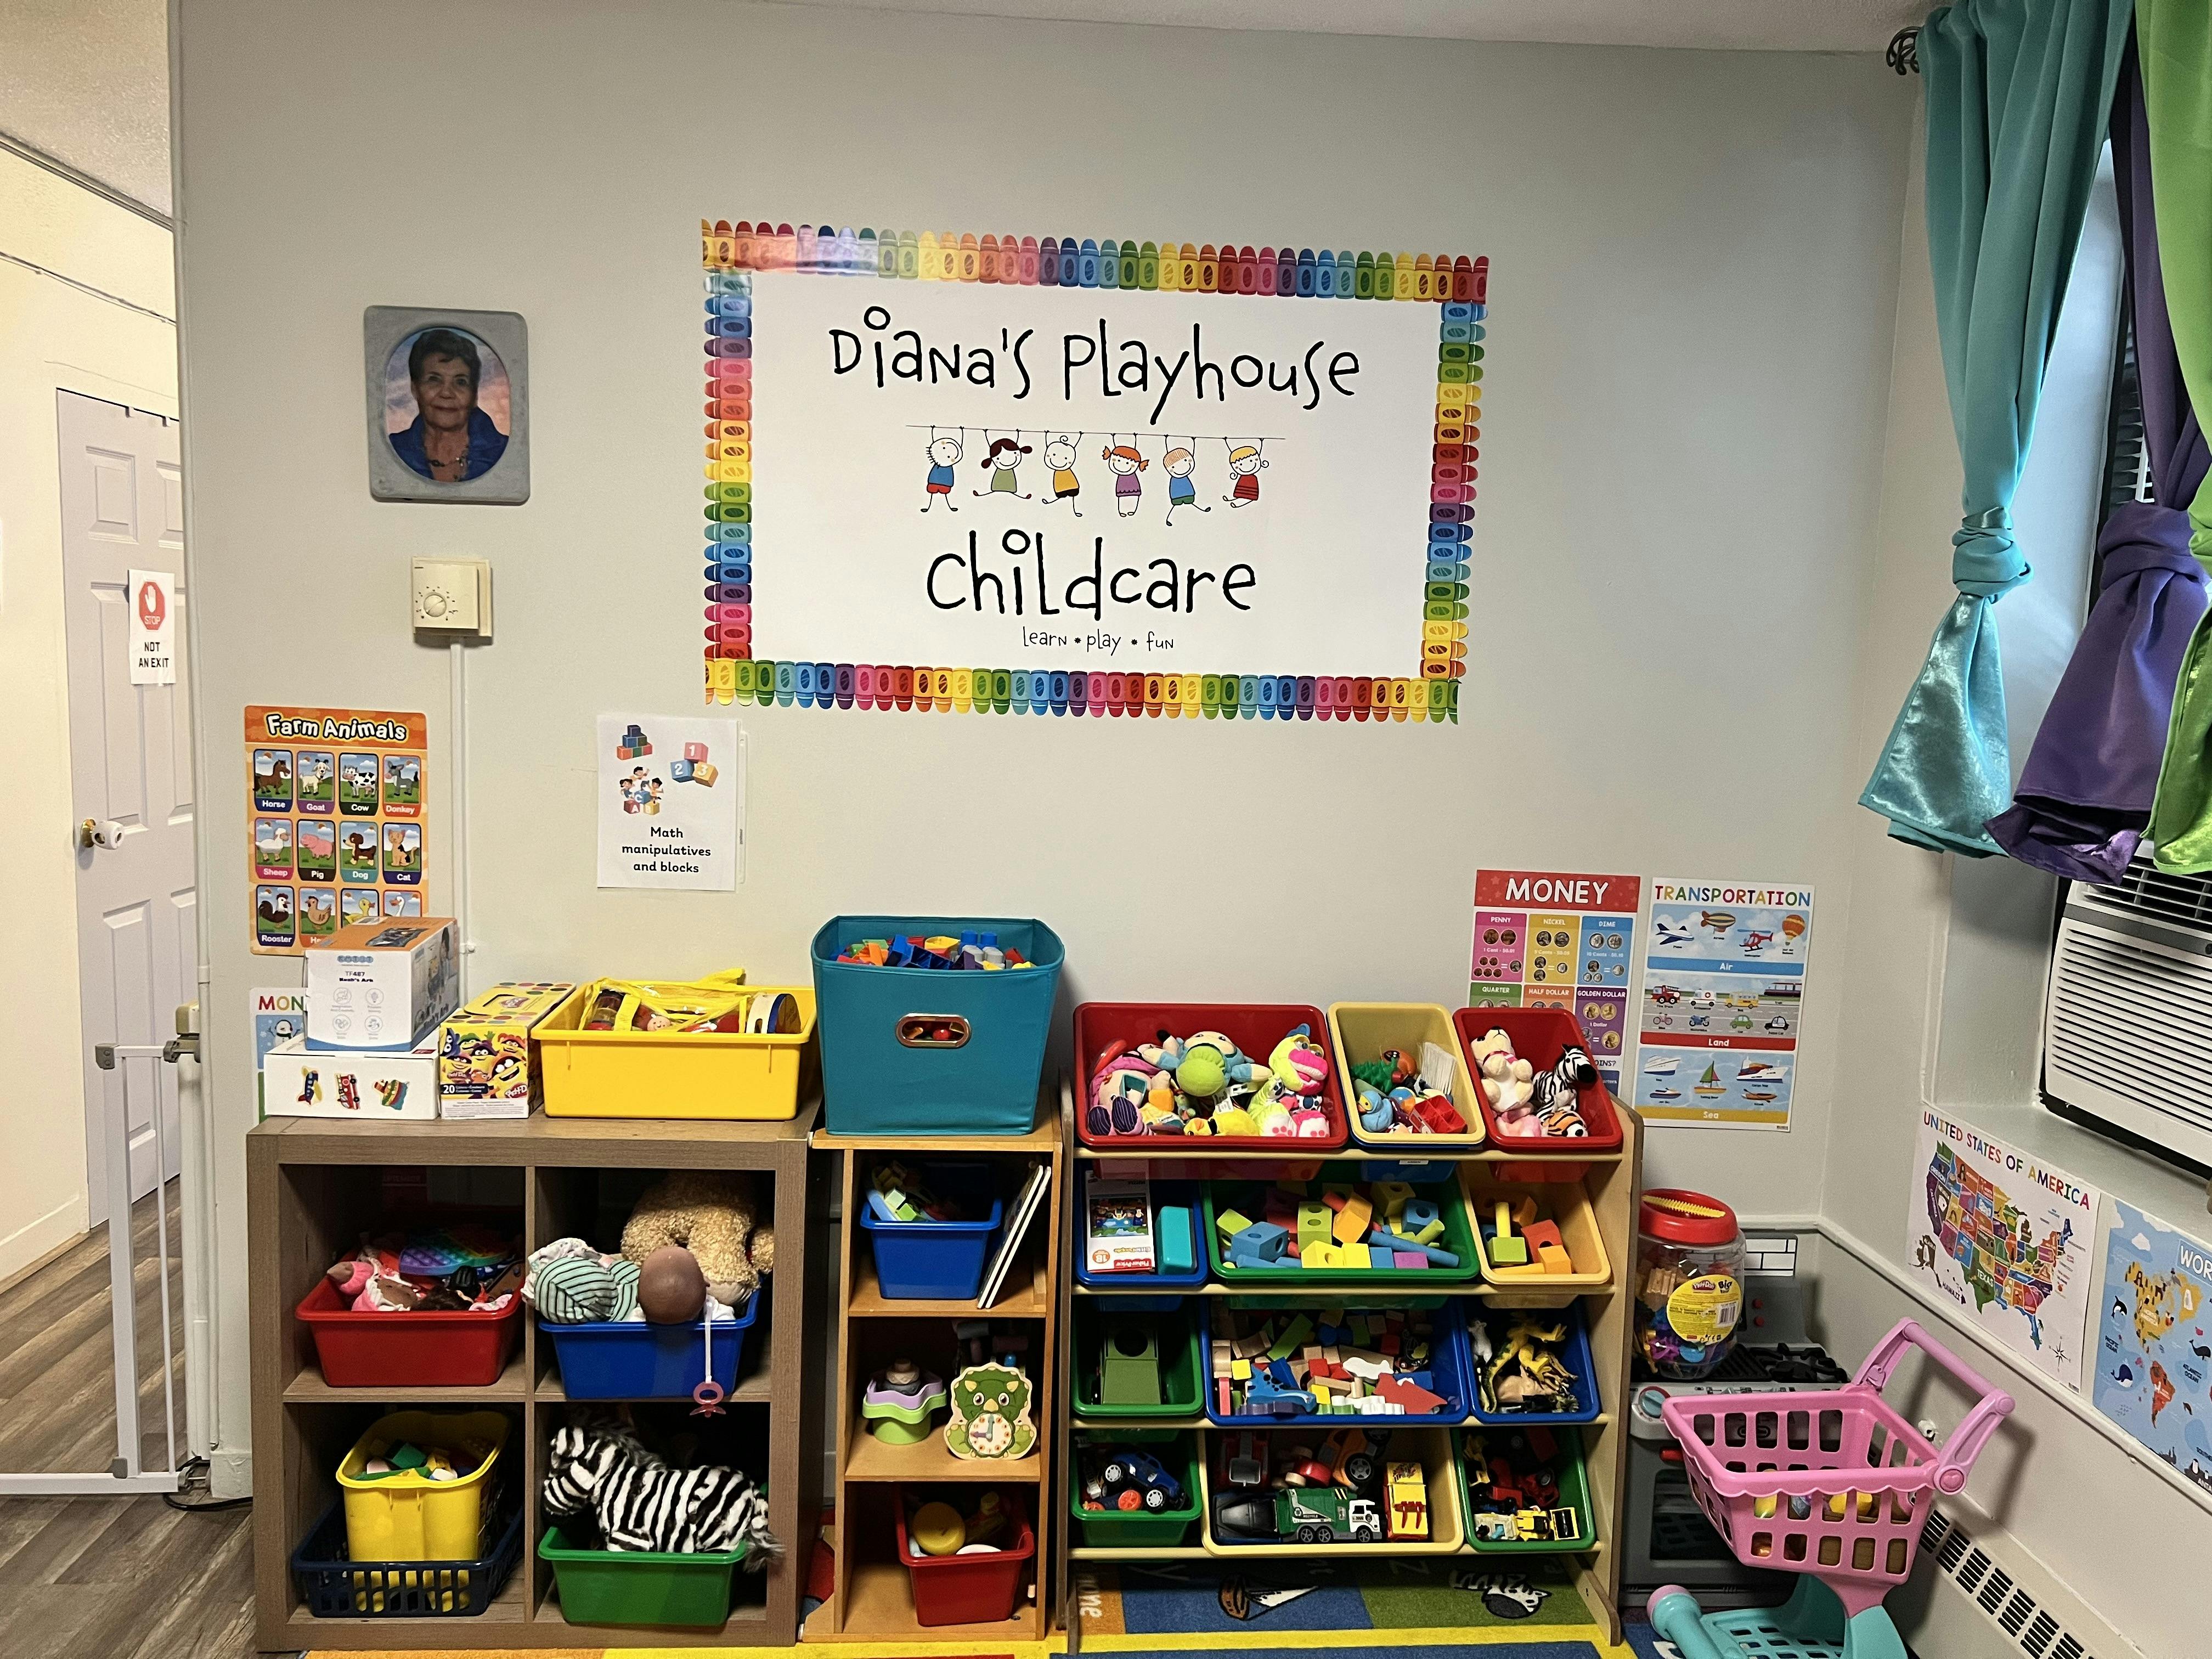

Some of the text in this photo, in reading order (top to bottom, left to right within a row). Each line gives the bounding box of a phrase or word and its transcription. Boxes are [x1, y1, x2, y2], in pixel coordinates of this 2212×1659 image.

[1064, 318, 1359, 425] Playhouse
[927, 529, 1256, 621] Childcare
[144, 615, 161, 625] STOP
[144, 642, 160, 652] NOT
[1023, 627, 1174, 656] learn play fun
[139, 658, 169, 668] AN EXIT
[266, 714, 407, 741] Farm Animals
[386, 805, 415, 814] Donkey
[651, 826, 683, 838] Math
[622, 844, 711, 857] manipulatives
[263, 868, 288, 877] Sheep
[634, 861, 699, 873] and blocks
[311, 870, 324, 879] Pig
[352, 871, 368, 880] Dog
[1505, 878, 1609, 905] MONEY
[1655, 885, 1810, 906] TRANSPORTATION
[1719, 962, 1733, 970] Air
[1708, 1038, 1729, 1047] Land
[443, 1085, 455, 1094] 20
[1703, 1110, 1719, 1119] Sea
[1923, 1111, 1963, 1141] UNITED
[1967, 1133, 2001, 1164] STATES
[2006, 1155, 2024, 1173] OF
[2028, 1165, 2090, 1210] AMERICA
[1977, 1268, 1994, 1288] TEXAS
[1942, 1282, 1960, 1301] HAWAII
